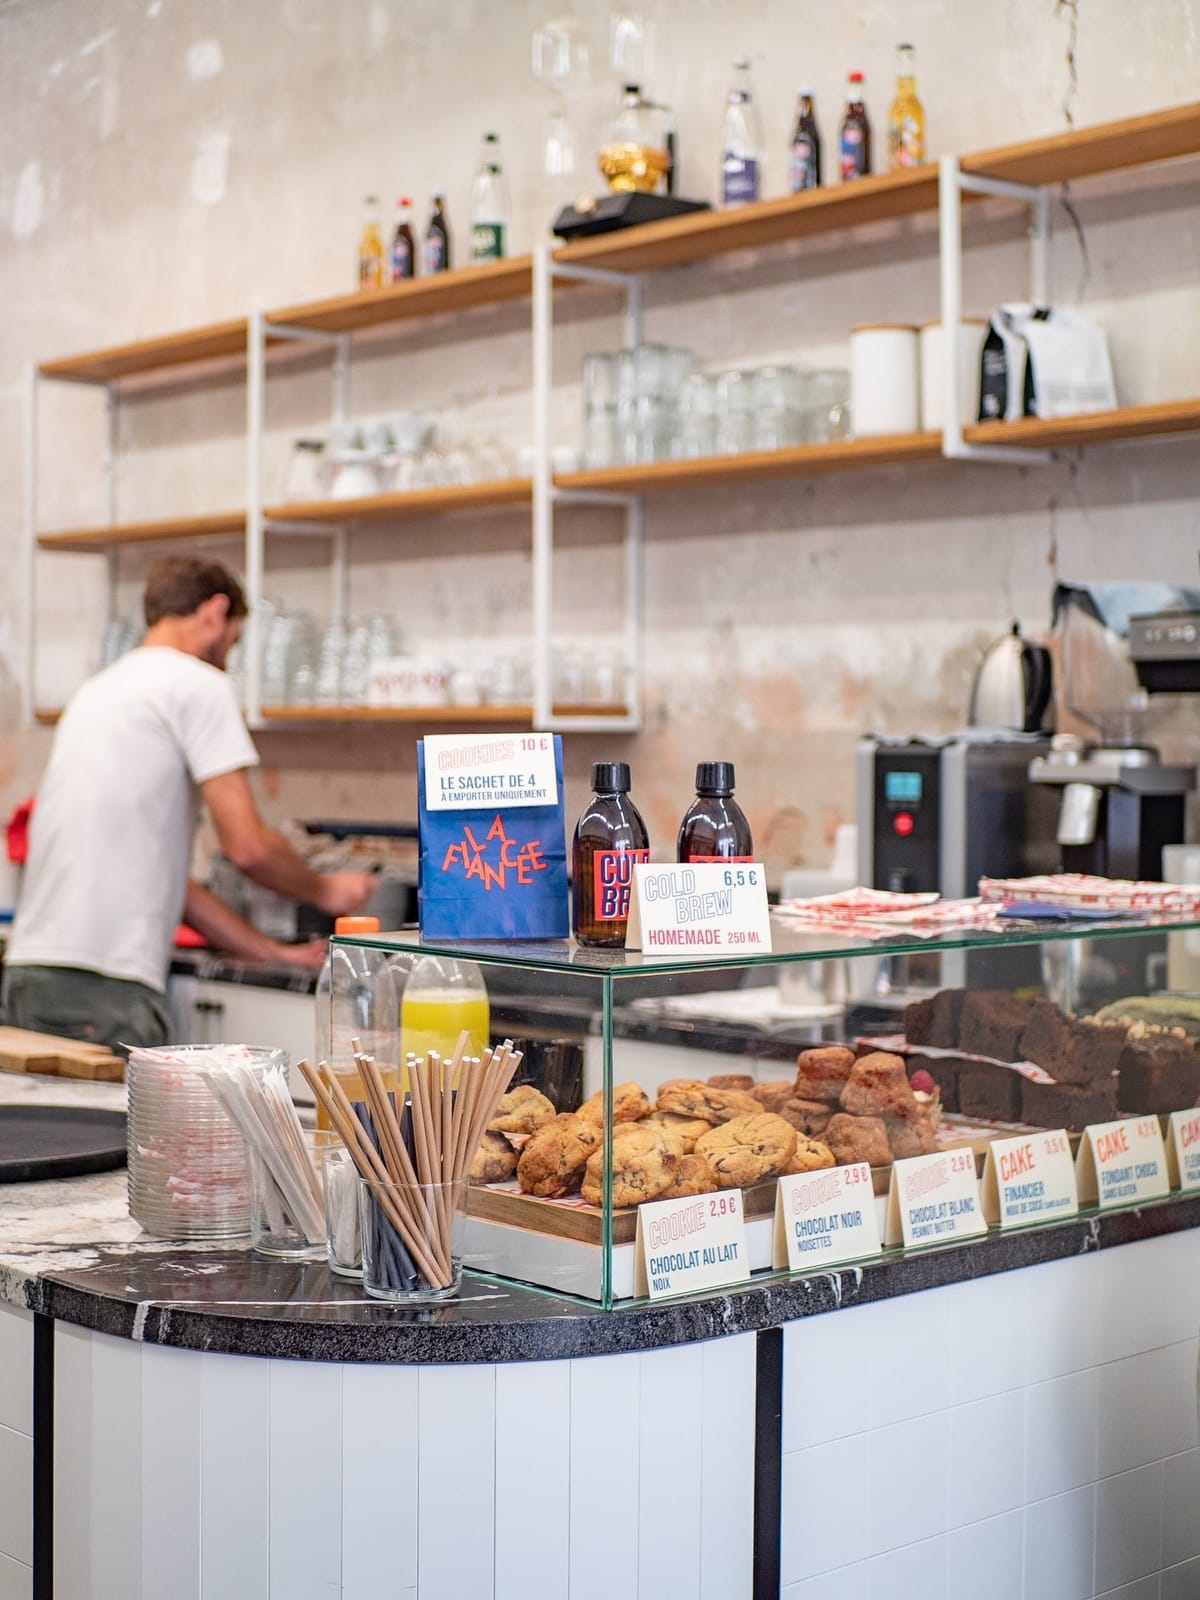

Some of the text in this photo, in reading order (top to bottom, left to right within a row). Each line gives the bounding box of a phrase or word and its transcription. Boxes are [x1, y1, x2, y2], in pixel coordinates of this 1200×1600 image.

[439, 741, 514, 771] COOKIES
[520, 738, 536, 751] 10
[440, 774, 536, 790] LE SACHET DE 4
[441, 789, 546, 801] À EMPORTER UNIQUEMENT
[601, 853, 649, 886] CO
[645, 869, 695, 901] COLD
[724, 870, 745, 888] 6,5
[602, 886, 631, 918] BR
[675, 889, 733, 924] BREW
[649, 929, 761, 945] HOMEMADE 250 ML
[1096, 1126, 1130, 1163] CAKE
[1000, 1142, 1036, 1182] CAKE
[791, 1170, 841, 1215] COOKIE
[1005, 1180, 1045, 1202] FINANCIER
[649, 1201, 706, 1250] COOKIE
[710, 1198, 727, 1217] 2,9
[795, 1210, 862, 1238] CHOCOLAT NOIR
[909, 1196, 975, 1224] CHOCOLAT BLANC
[650, 1243, 738, 1275] CHOCOLAT AU LAIT
[798, 1235, 832, 1252] NOISETTES
[652, 1276, 671, 1292] NOIX
